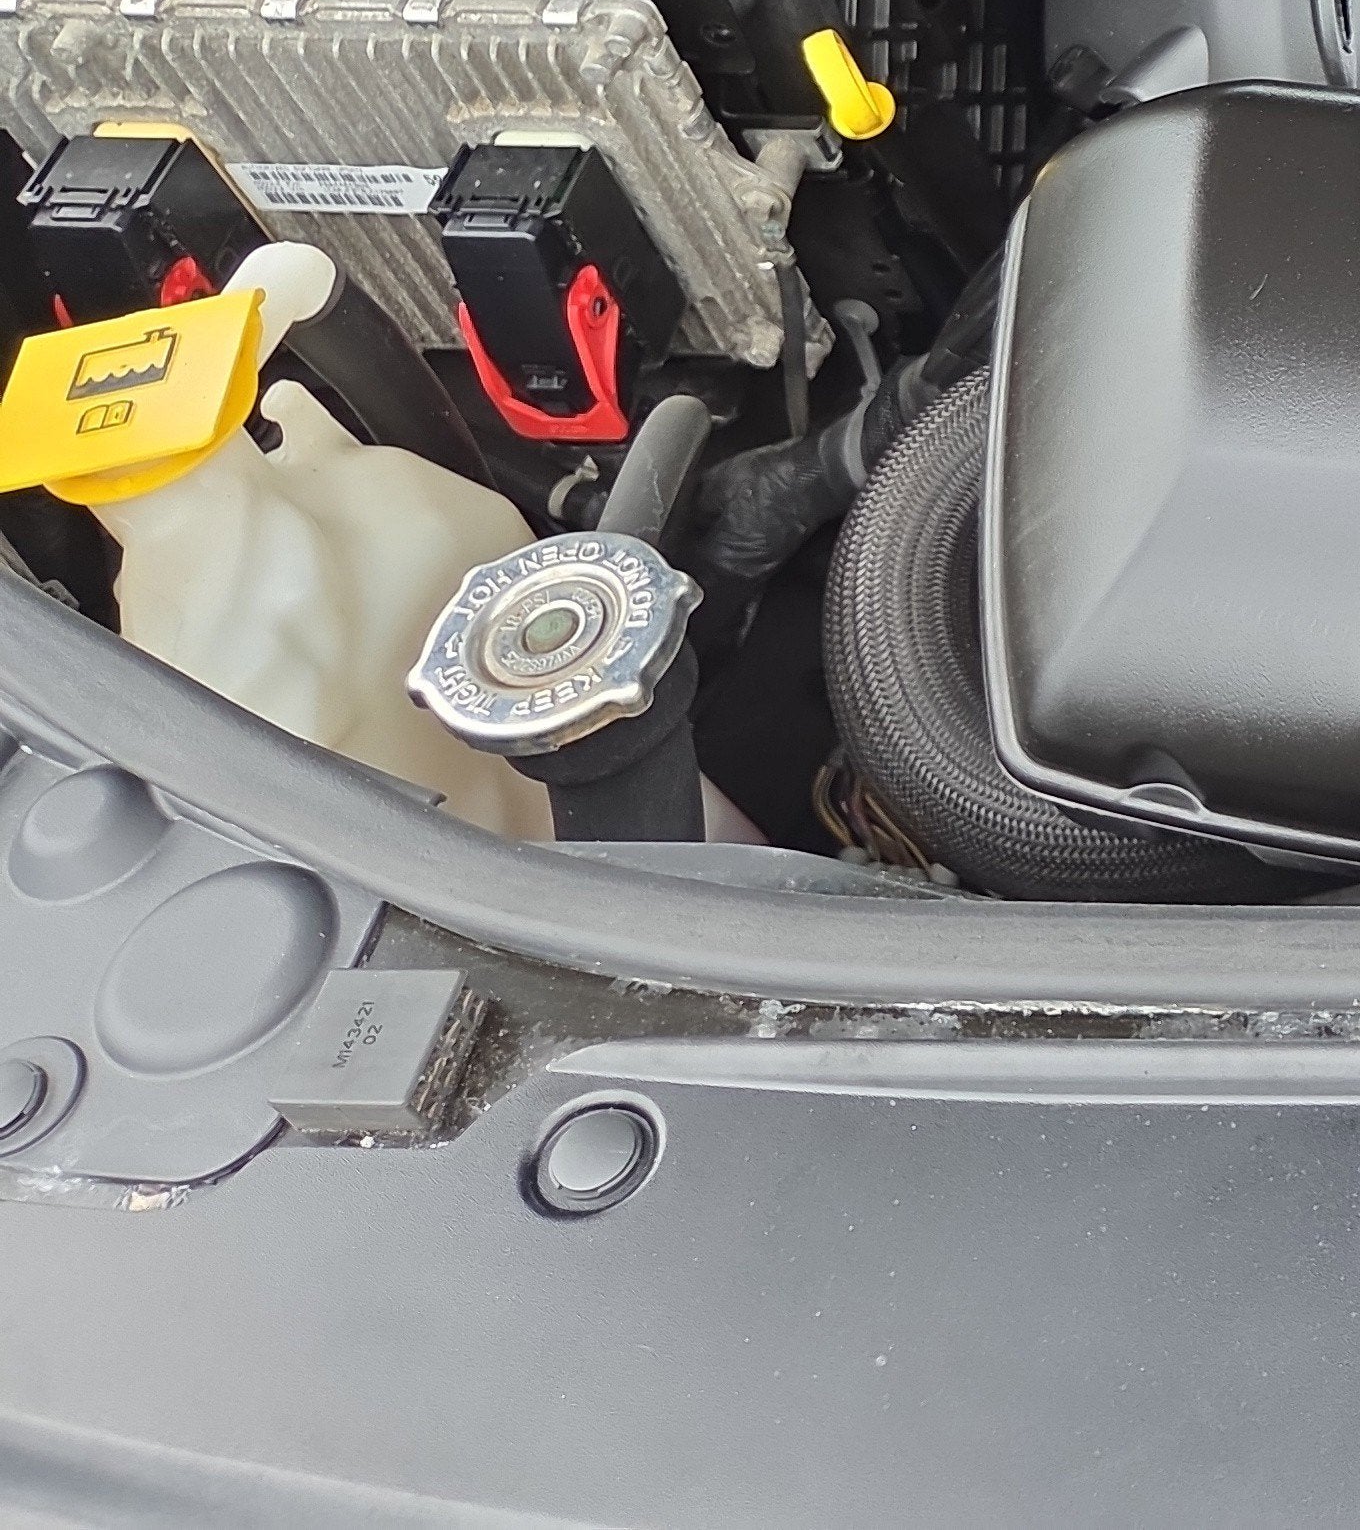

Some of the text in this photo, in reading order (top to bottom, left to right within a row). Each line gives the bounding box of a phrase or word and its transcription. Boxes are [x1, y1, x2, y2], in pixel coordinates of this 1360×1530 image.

[453, 568, 514, 622] HOT
[434, 664, 603, 717] KEEP TIGHT
[362, 1024, 383, 1045] 02
